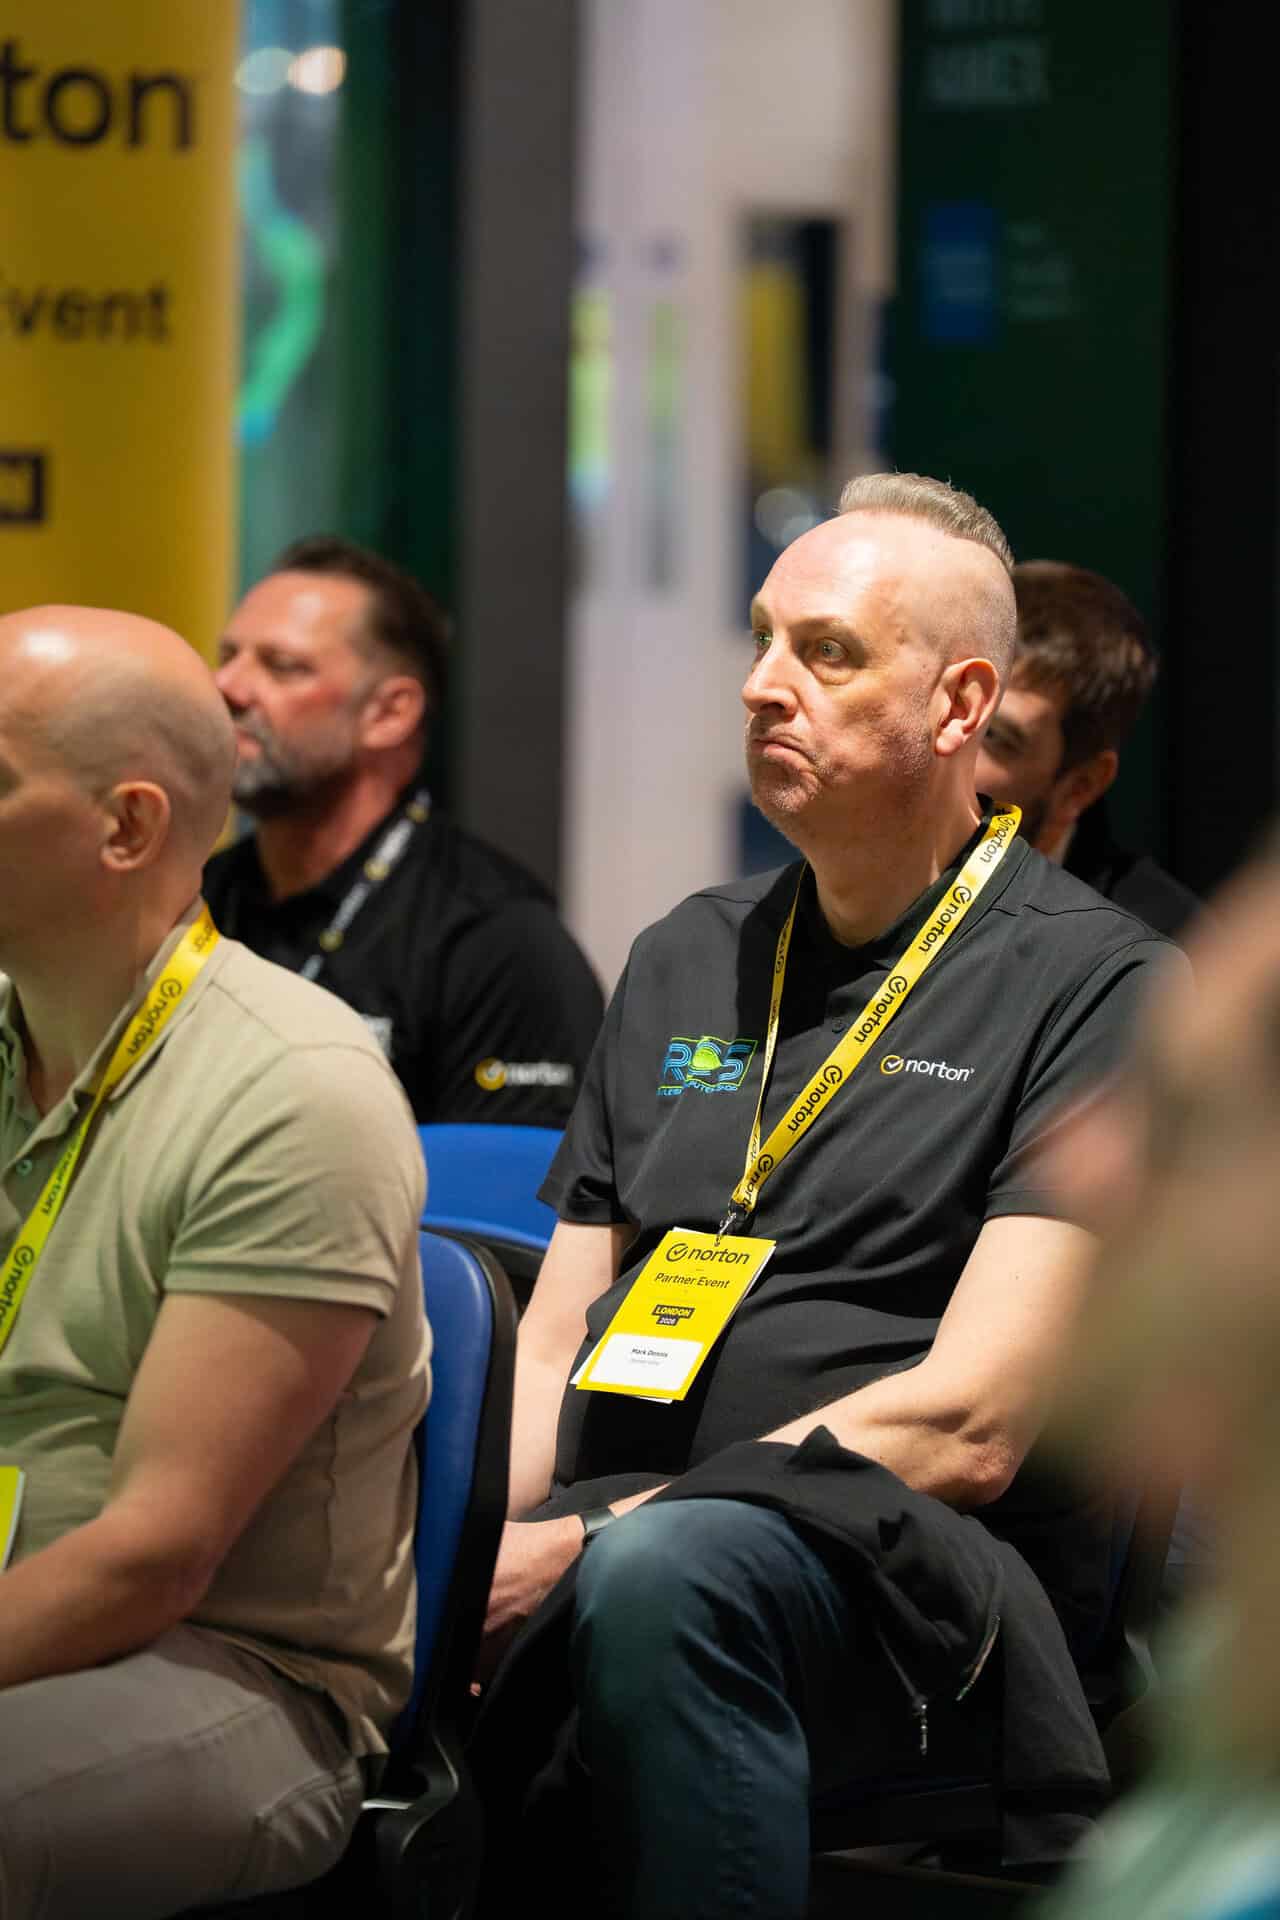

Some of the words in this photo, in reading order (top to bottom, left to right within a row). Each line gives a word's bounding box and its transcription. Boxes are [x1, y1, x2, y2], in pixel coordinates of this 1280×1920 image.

[0, 279, 172, 345] vent
[980, 824, 1009, 863] norton
[918, 902, 959, 953] norton
[127, 999, 167, 1056] norton
[854, 992, 895, 1043] norton
[905, 1060, 970, 1082] norton
[787, 1082, 829, 1133] norton
[687, 1246, 750, 1265] norton
[654, 1272, 696, 1286] Partner
[697, 1276, 731, 1289] Event
[655, 1306, 692, 1318] LONDON
